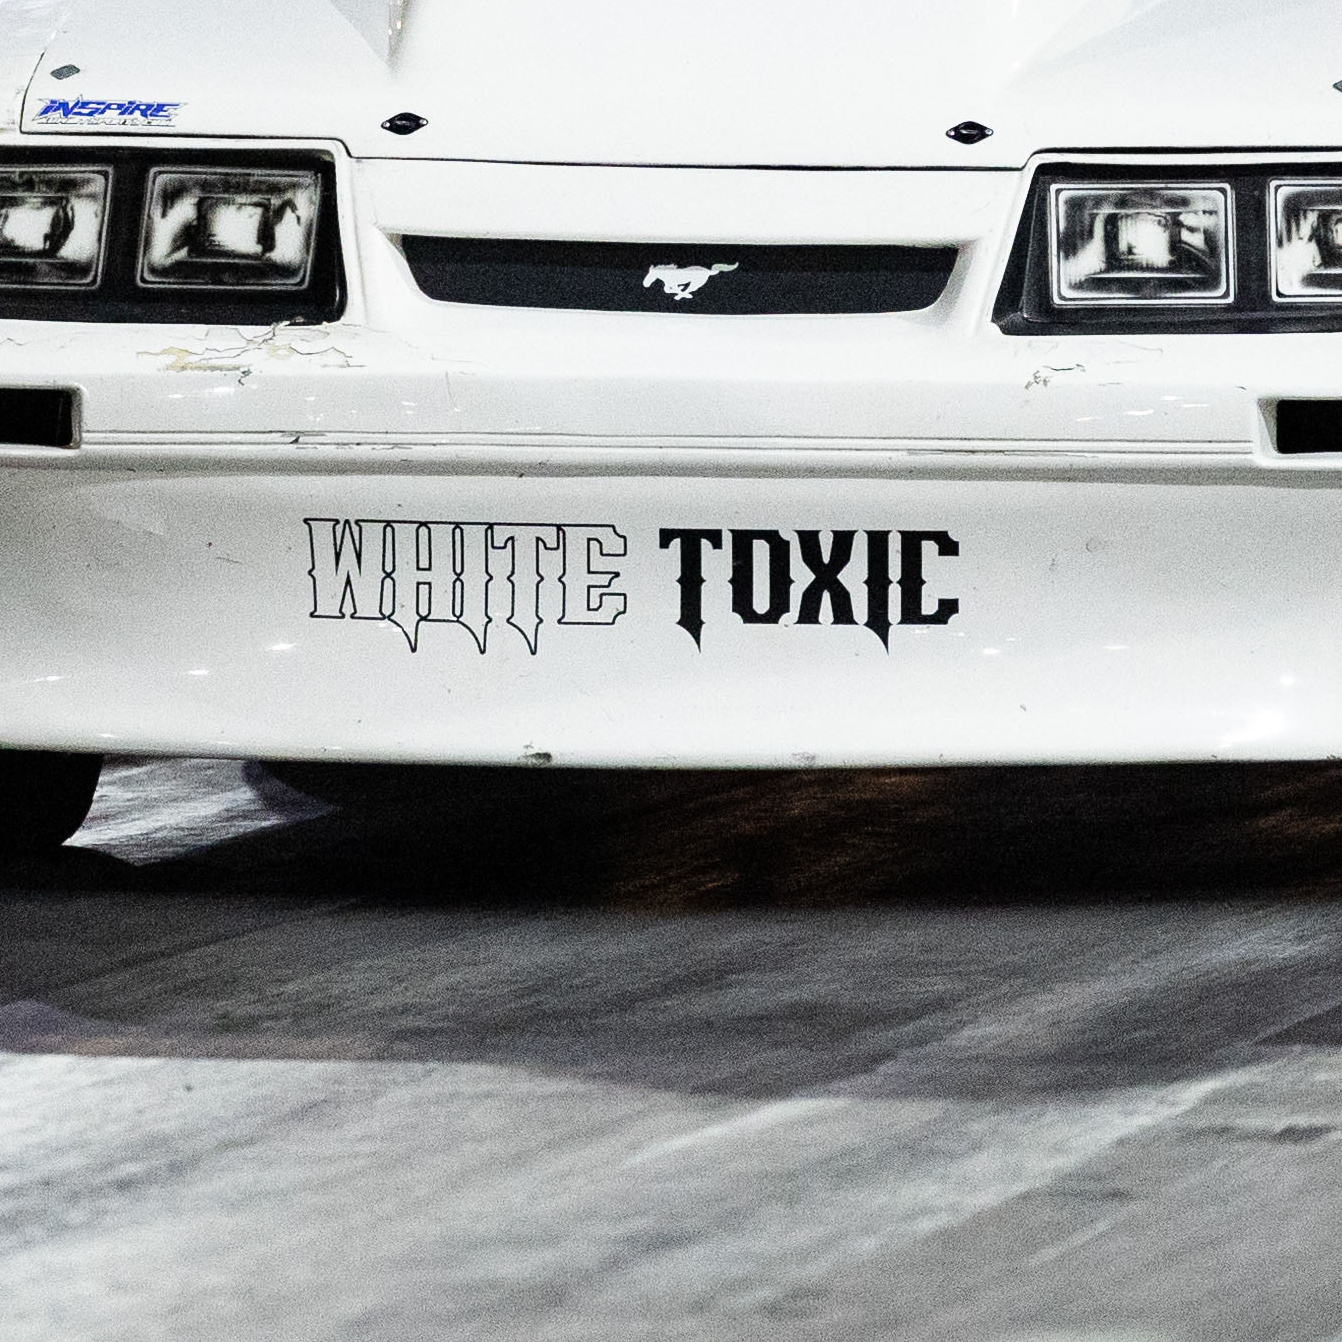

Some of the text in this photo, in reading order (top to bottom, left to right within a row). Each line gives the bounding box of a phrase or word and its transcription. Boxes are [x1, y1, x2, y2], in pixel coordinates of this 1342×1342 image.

[37, 98, 181, 118] INSPIRE
[302, 518, 960, 655] WHITE TOXIC
